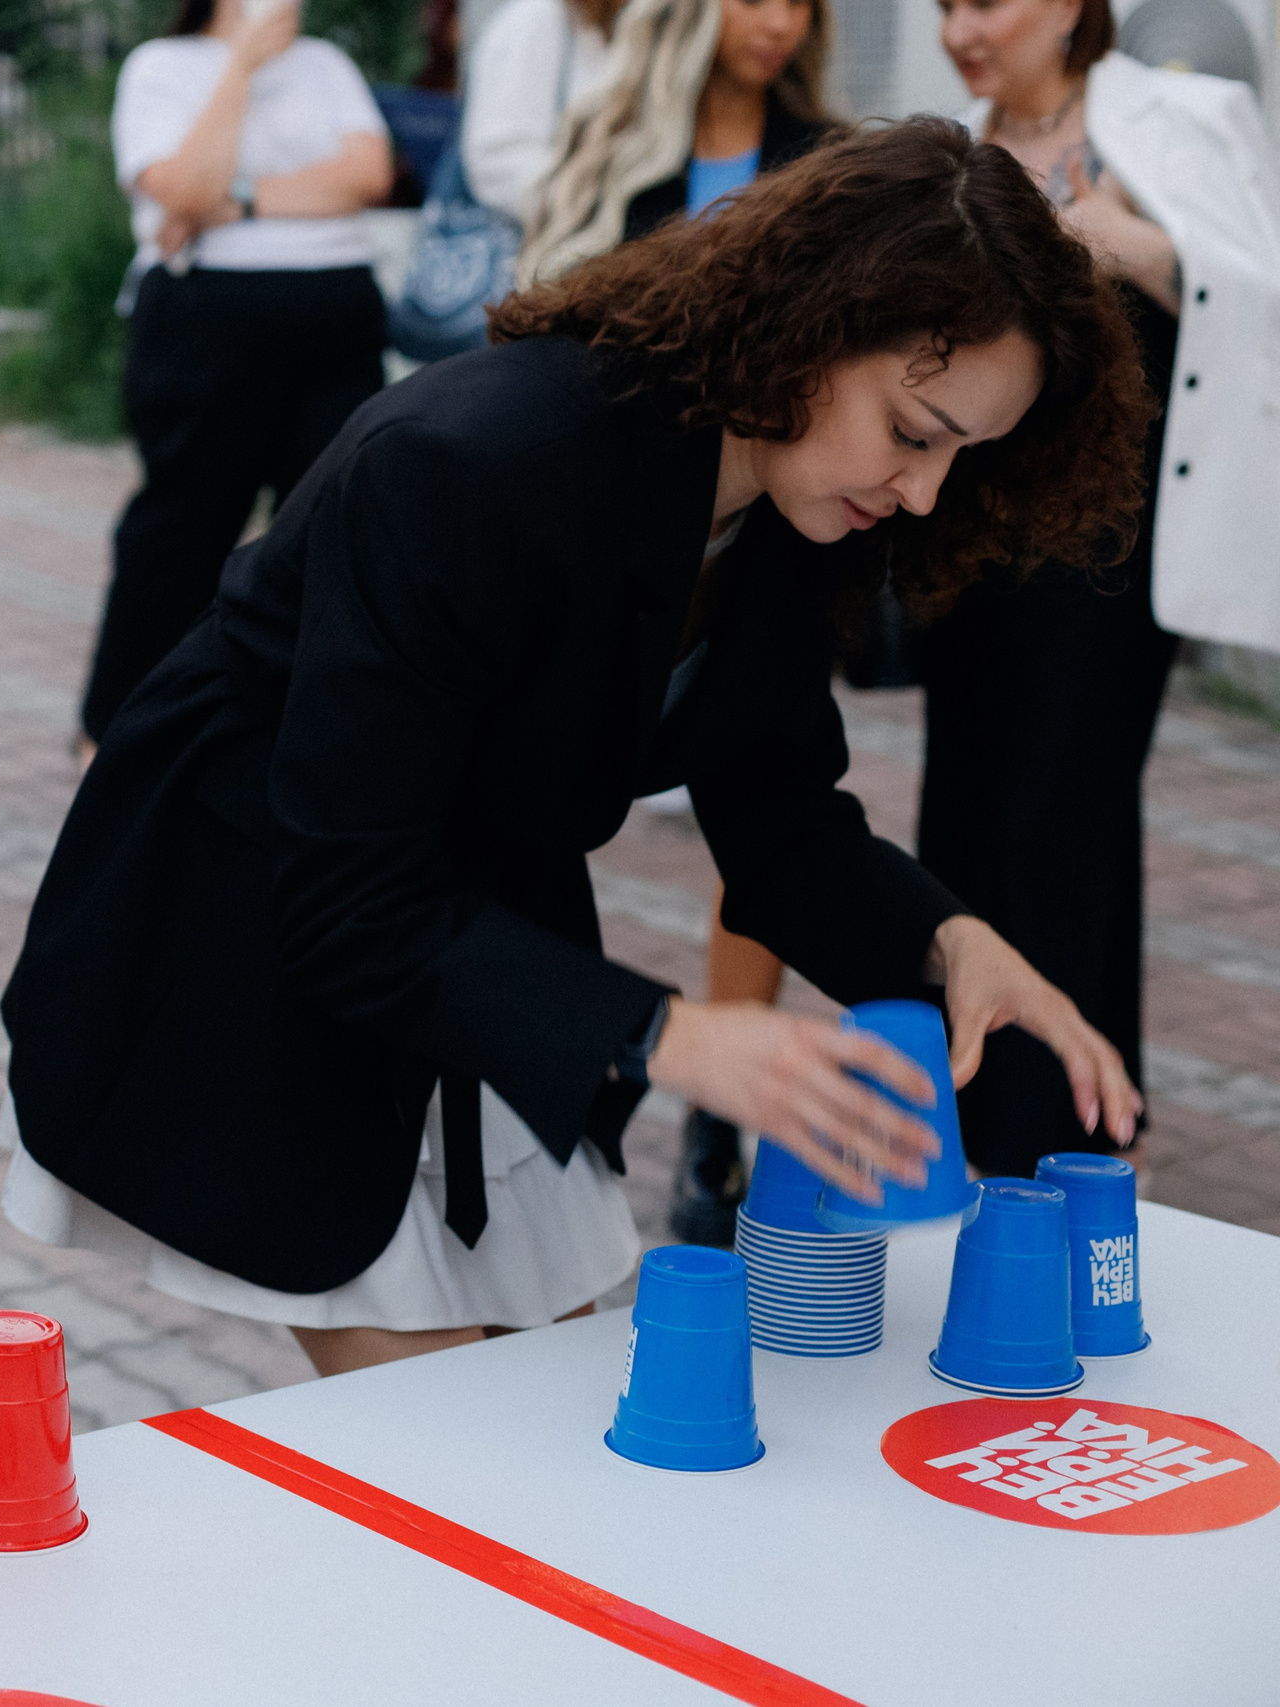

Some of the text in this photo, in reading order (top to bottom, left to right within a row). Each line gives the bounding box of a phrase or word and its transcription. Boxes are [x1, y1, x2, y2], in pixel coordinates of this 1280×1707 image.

[1091, 1257, 1134, 1285] ЕРИ
[1093, 1279, 1134, 1307] ВЕЧ
[924, 1446, 1134, 1520] ВЕЧ
[979, 1426, 1192, 1502] ЕРИ
